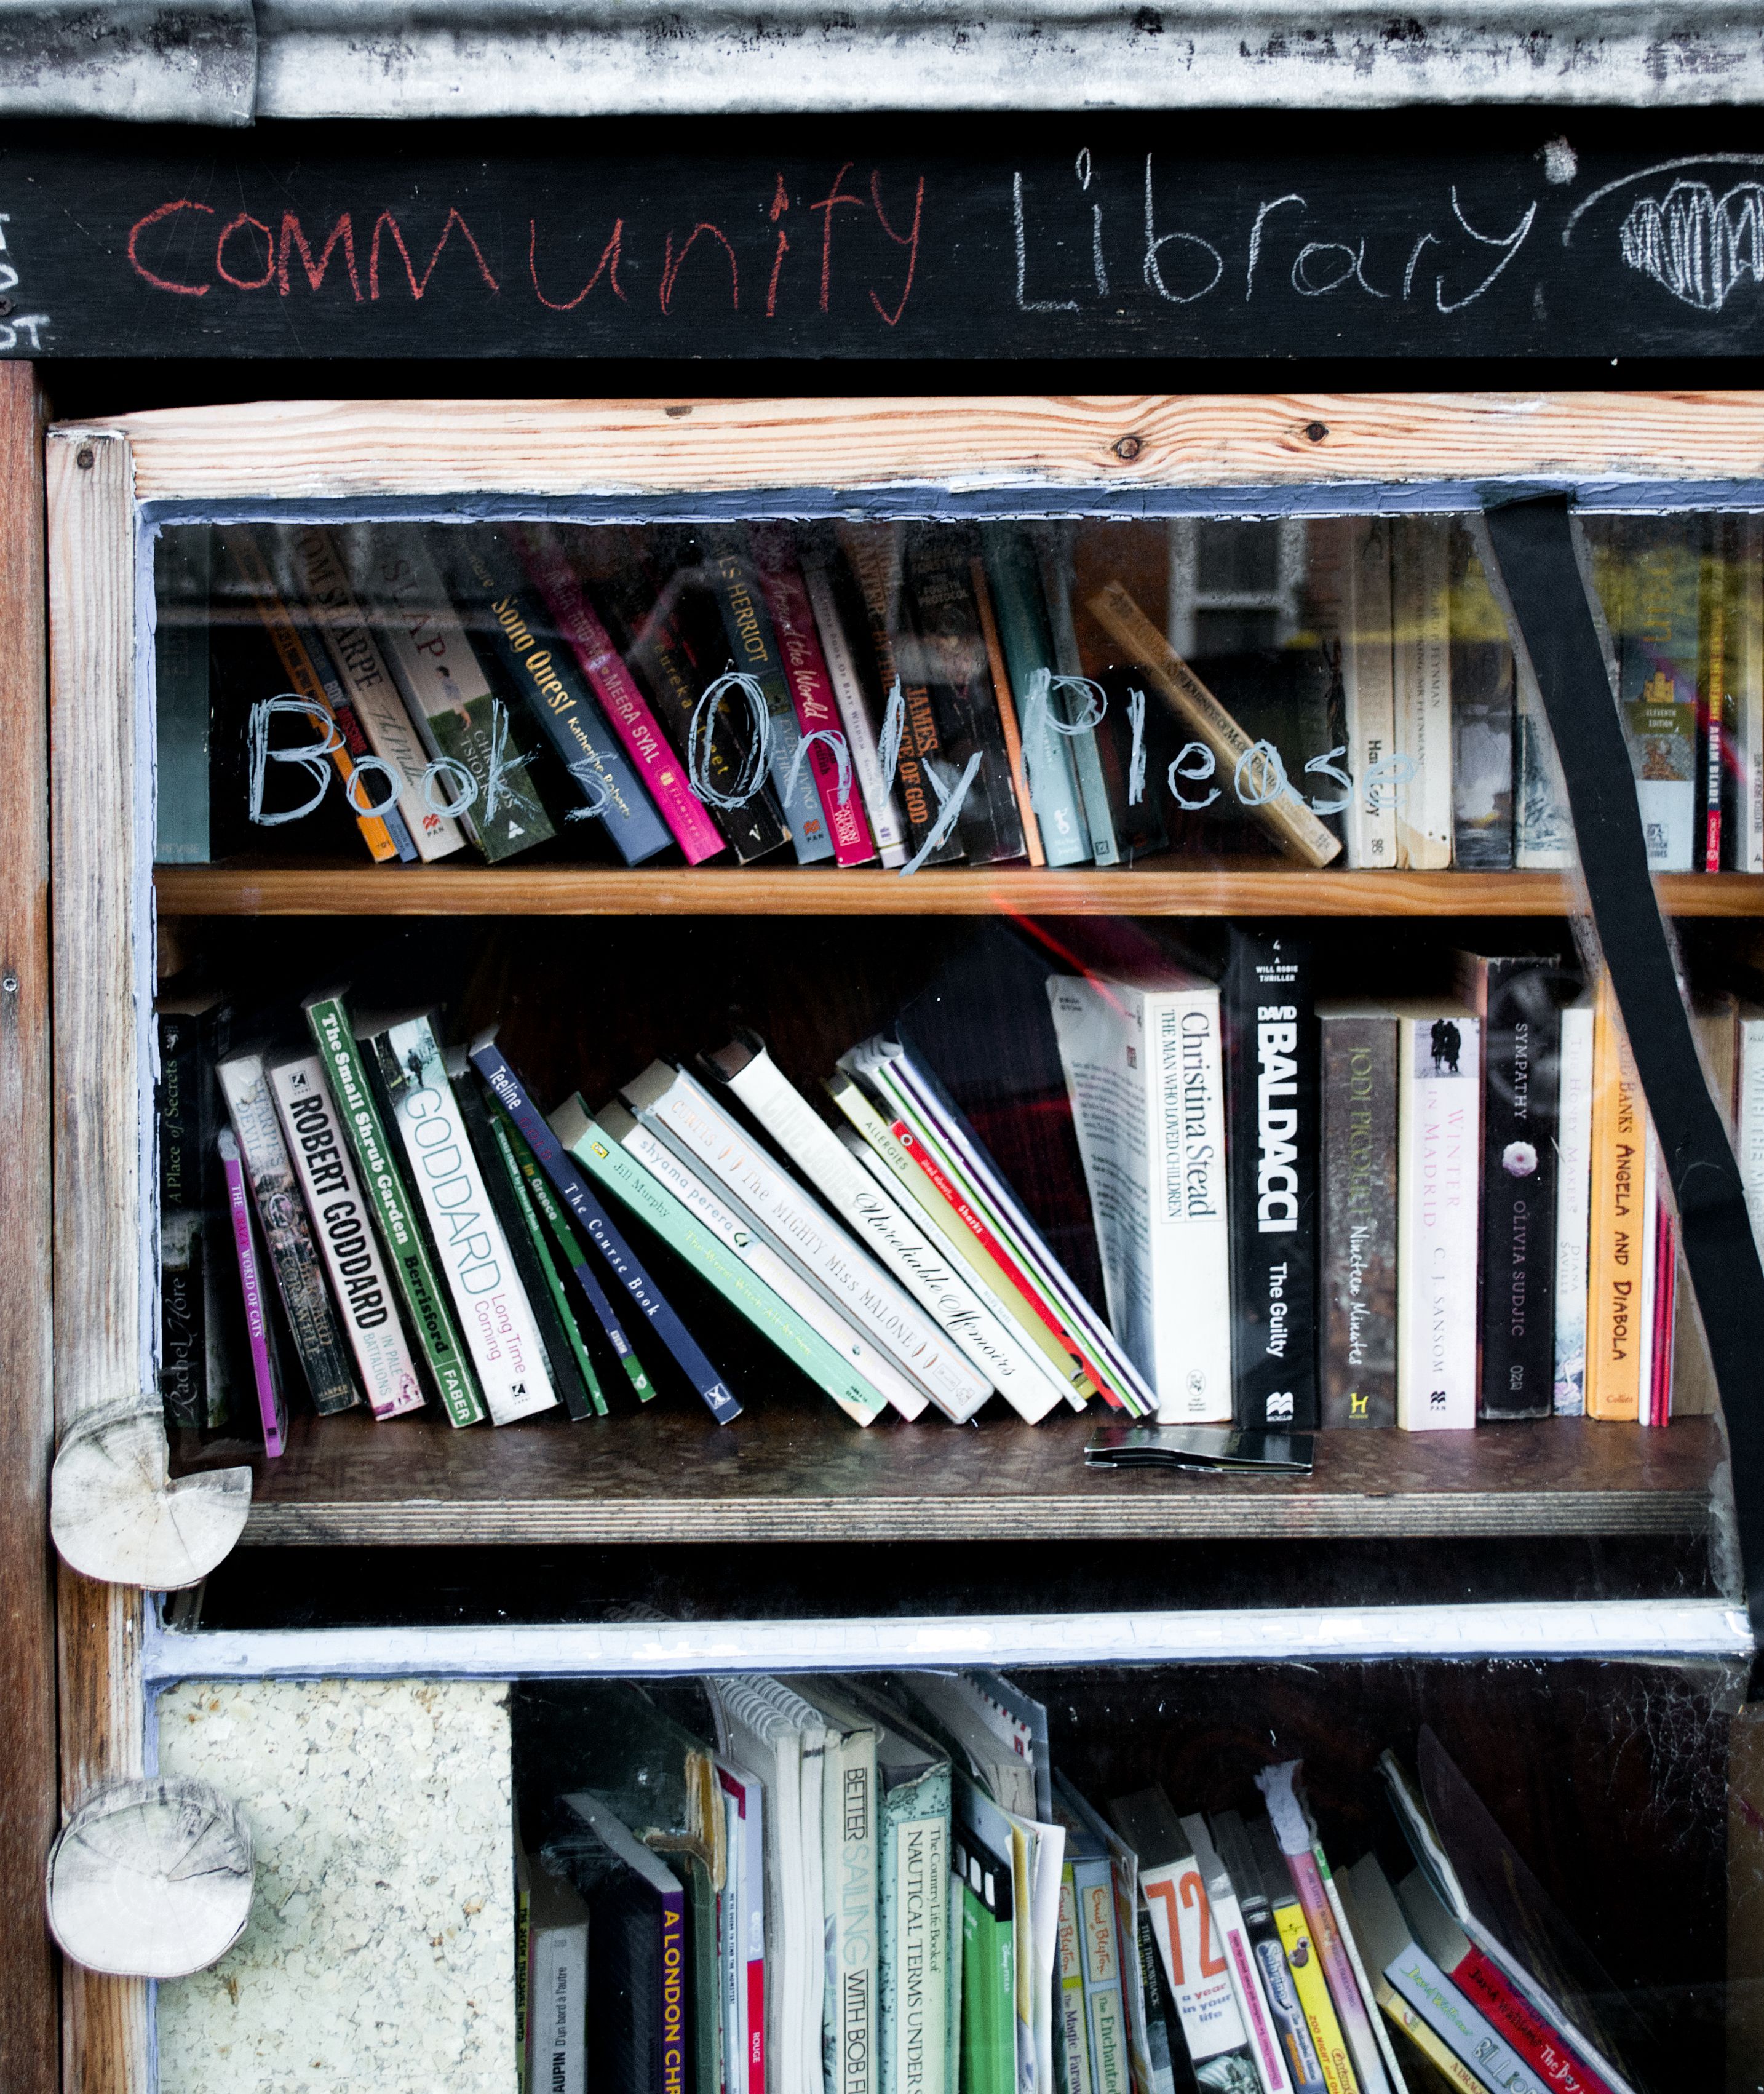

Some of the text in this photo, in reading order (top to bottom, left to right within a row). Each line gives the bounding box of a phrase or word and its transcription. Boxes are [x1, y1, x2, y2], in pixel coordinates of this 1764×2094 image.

[1014, 146, 1537, 313] Library
[488, 594, 538, 655] Song
[523, 648, 577, 717] Quest
[725, 582, 769, 666] HERRIOT
[651, 642, 695, 710] eureka
[784, 637, 828, 725] the World
[1430, 647, 1439, 708] FEYNMAN
[600, 671, 661, 764] MEERA SYAL
[904, 684, 939, 756] JAMES,
[1709, 727, 1720, 762] ADAM
[689, 658, 983, 877] Only
[1021, 666, 1416, 816] Please
[898, 759, 918, 784] OF
[903, 784, 928, 825] GOD
[1708, 765, 1719, 805] BLADE
[426, 824, 445, 838] PAN
[832, 808, 851, 844] WORK
[1258, 1006, 1297, 1021] DAVID
[1512, 1022, 1529, 1120] SYMPATHY
[1567, 1078, 1581, 1134] HONEY
[1613, 1079, 1639, 1134] BANKS
[164, 1059, 184, 1203] A Place of Secrets
[235, 1099, 264, 1155] DEVIL
[864, 1119, 910, 1172] ALLERGIES
[1160, 1009, 1184, 1218] THE MAN WHO LOVED CHILDREN
[1178, 1011, 1217, 1219] Christina Stead
[1258, 1022, 1298, 1233] BALDACCI
[1348, 1046, 1372, 1216] JODI PICOULT
[318, 1012, 450, 1355] The Small Shrub Garden Berrisford
[395, 1085, 507, 1298] GODDARD
[487, 1065, 526, 1111] Teeline
[563, 1182, 591, 1215] The
[587, 1217, 632, 1275] Course
[627, 1276, 661, 1318] Book
[611, 1160, 673, 1222] Jill Murphy
[634, 1136, 734, 1239] shyama perera
[1423, 1089, 1440, 1227] IN MADRID
[1444, 1108, 1466, 1207] WINTER
[1565, 1147, 1578, 1213] MAKERS
[288, 1094, 391, 1331] ROBERT GODDARD
[530, 1176, 560, 1222] Greece
[667, 1097, 920, 1350] CURTIS The MIGHTY Miss MALONE
[956, 1202, 985, 1235] Sharks
[230, 1184, 263, 1338] THE CRAZY WORLD OF CATS
[849, 1184, 953, 1299] Unreliable
[931, 1286, 1022, 1385] Memoirs
[1512, 1200, 1526, 1336] OLIVIA SUDJIC
[1559, 1241, 1570, 1296] SAVILLE
[1570, 1245, 1581, 1292] DIANA
[1610, 1144, 1635, 1361] ANGELA AND DIABOLA
[468, 1299, 506, 1363] Coming
[487, 1292, 531, 1374] Long Time
[1266, 1262, 1287, 1357] The Guilty
[1348, 1225, 1370, 1365] Nineteen Minutes
[1432, 1247, 1445, 1373] C. SANSOM
[164, 1340, 197, 1421] Rachel
[361, 1332, 393, 1398] BATTALIONS
[380, 1334, 404, 1377] IN PALE
[442, 1368, 471, 1421] FABER
[842, 1767, 868, 2072] BETTER SAILING WITH BOB
[926, 1826, 941, 1973] The Country Life Book of
[1091, 1888, 1111, 1977] Enid Blyton
[1140, 1923, 1153, 1945] THE
[1145, 1871, 1228, 1986] 72
[664, 1910, 680, 2042] A LONDON
[750, 1945, 761, 1954] 2
[905, 1830, 924, 2084] NAUTICAL TERMS UNDER
[1059, 1925, 1074, 1973] Blyton
[552, 1967, 566, 2093] AUPIN D'un bord l'autre
[1063, 1994, 1081, 2049] The Magic
[1099, 1997, 1109, 2013] The
[1182, 1993, 1232, 2014] in your
[1194, 1982, 1227, 2000] year
[1199, 2008, 1223, 2023] life
[752, 2031, 760, 2063] ROUGE
[1308, 2014, 1335, 2080] ZOO NIGHT and
[1536, 2044, 1564, 2071] The
